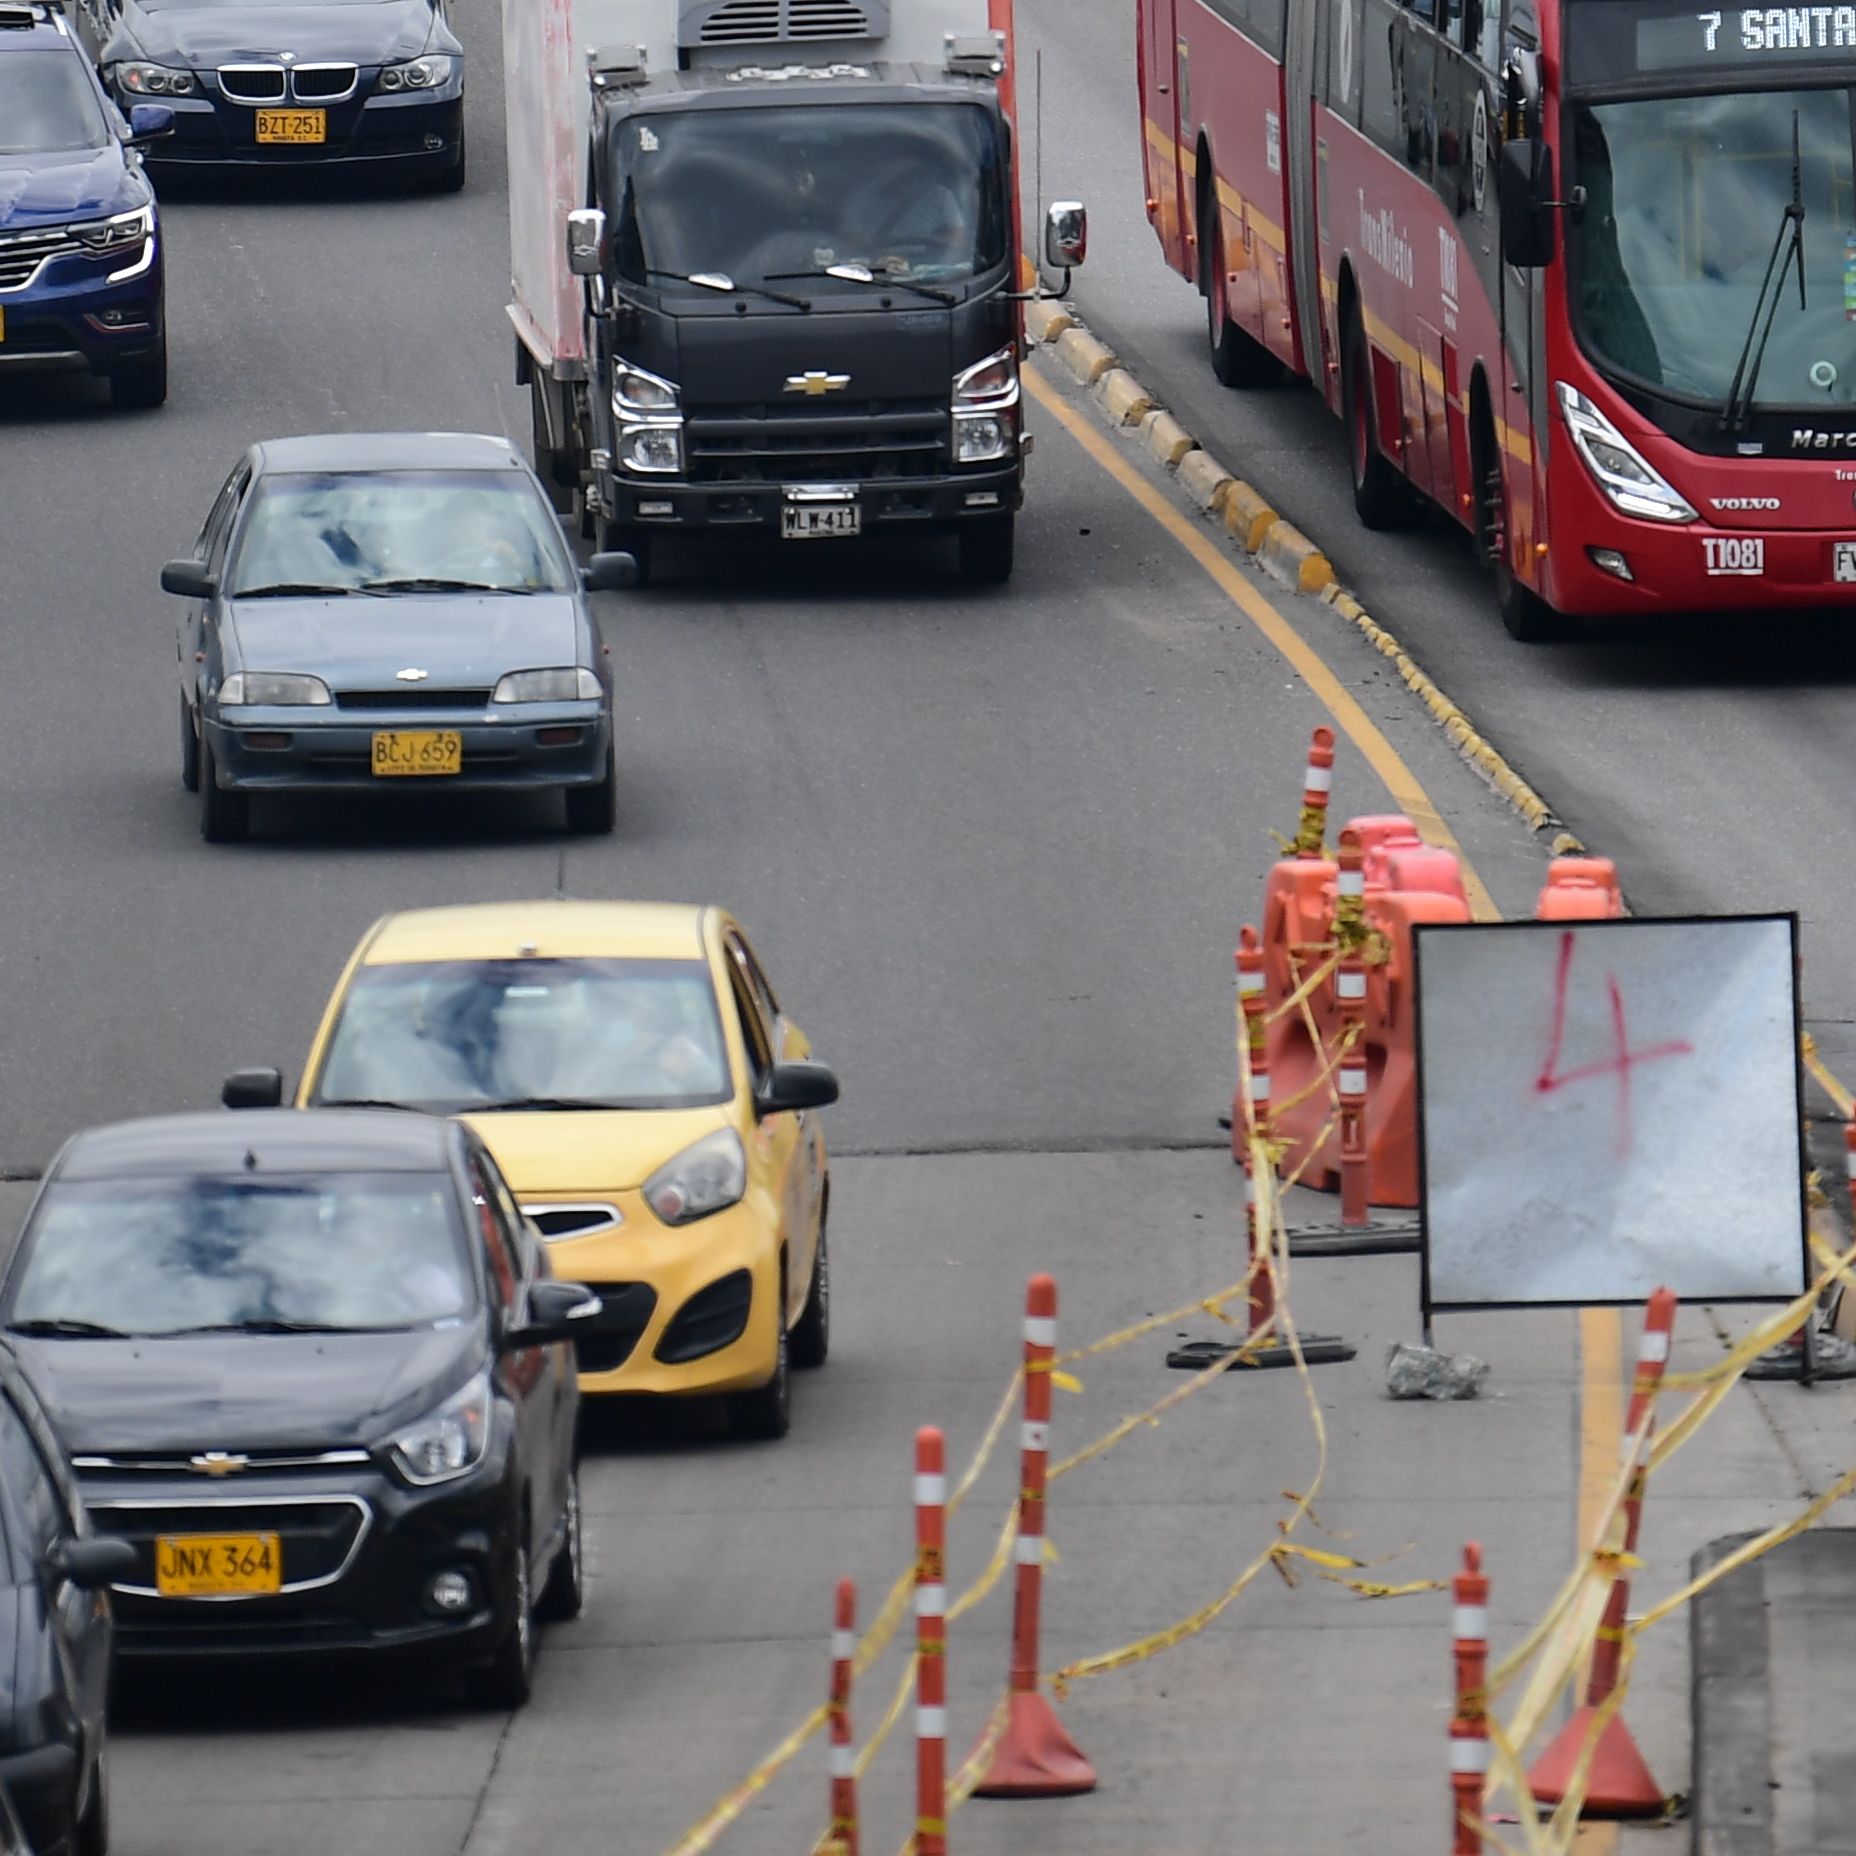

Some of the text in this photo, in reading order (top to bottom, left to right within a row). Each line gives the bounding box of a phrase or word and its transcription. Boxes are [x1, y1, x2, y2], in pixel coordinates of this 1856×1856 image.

[1697, 10, 1722, 51] 7
[1740, 6, 1856, 50] SANTA
[1709, 497, 1781, 510] VOLVO
[1702, 538, 1764, 569] T1081
[1534, 928, 1694, 1164] 4
